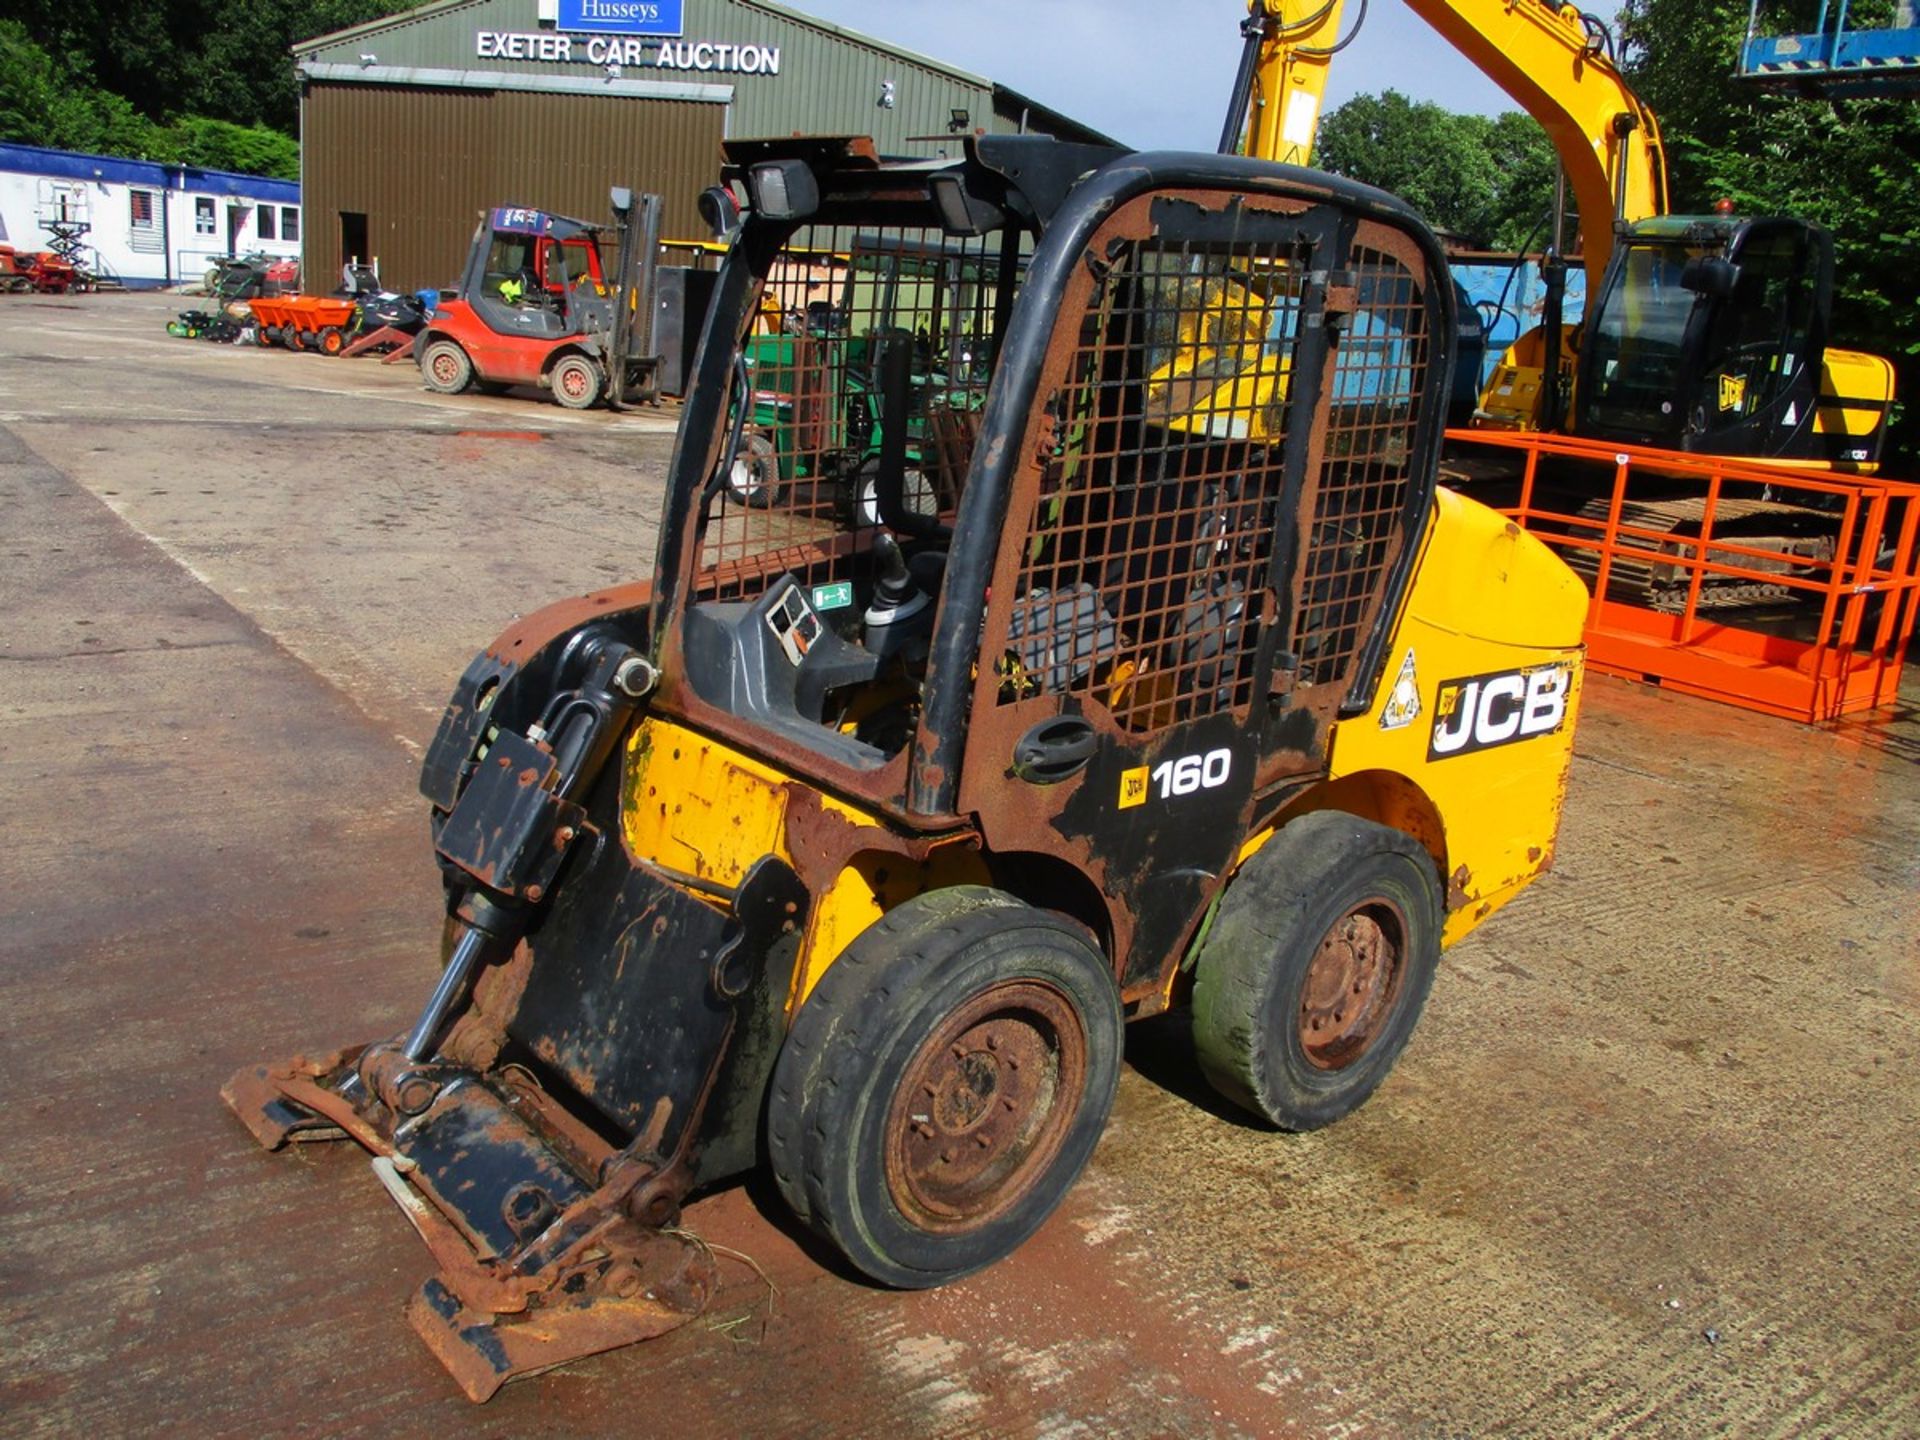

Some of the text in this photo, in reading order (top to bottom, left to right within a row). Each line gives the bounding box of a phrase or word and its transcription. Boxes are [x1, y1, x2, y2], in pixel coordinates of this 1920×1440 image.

[581, 0, 658, 23] Husseys
[476, 32, 780, 74] EXETER CAR AUCTION
[1432, 667, 1569, 753] JCB
[1152, 748, 1231, 799] 160
